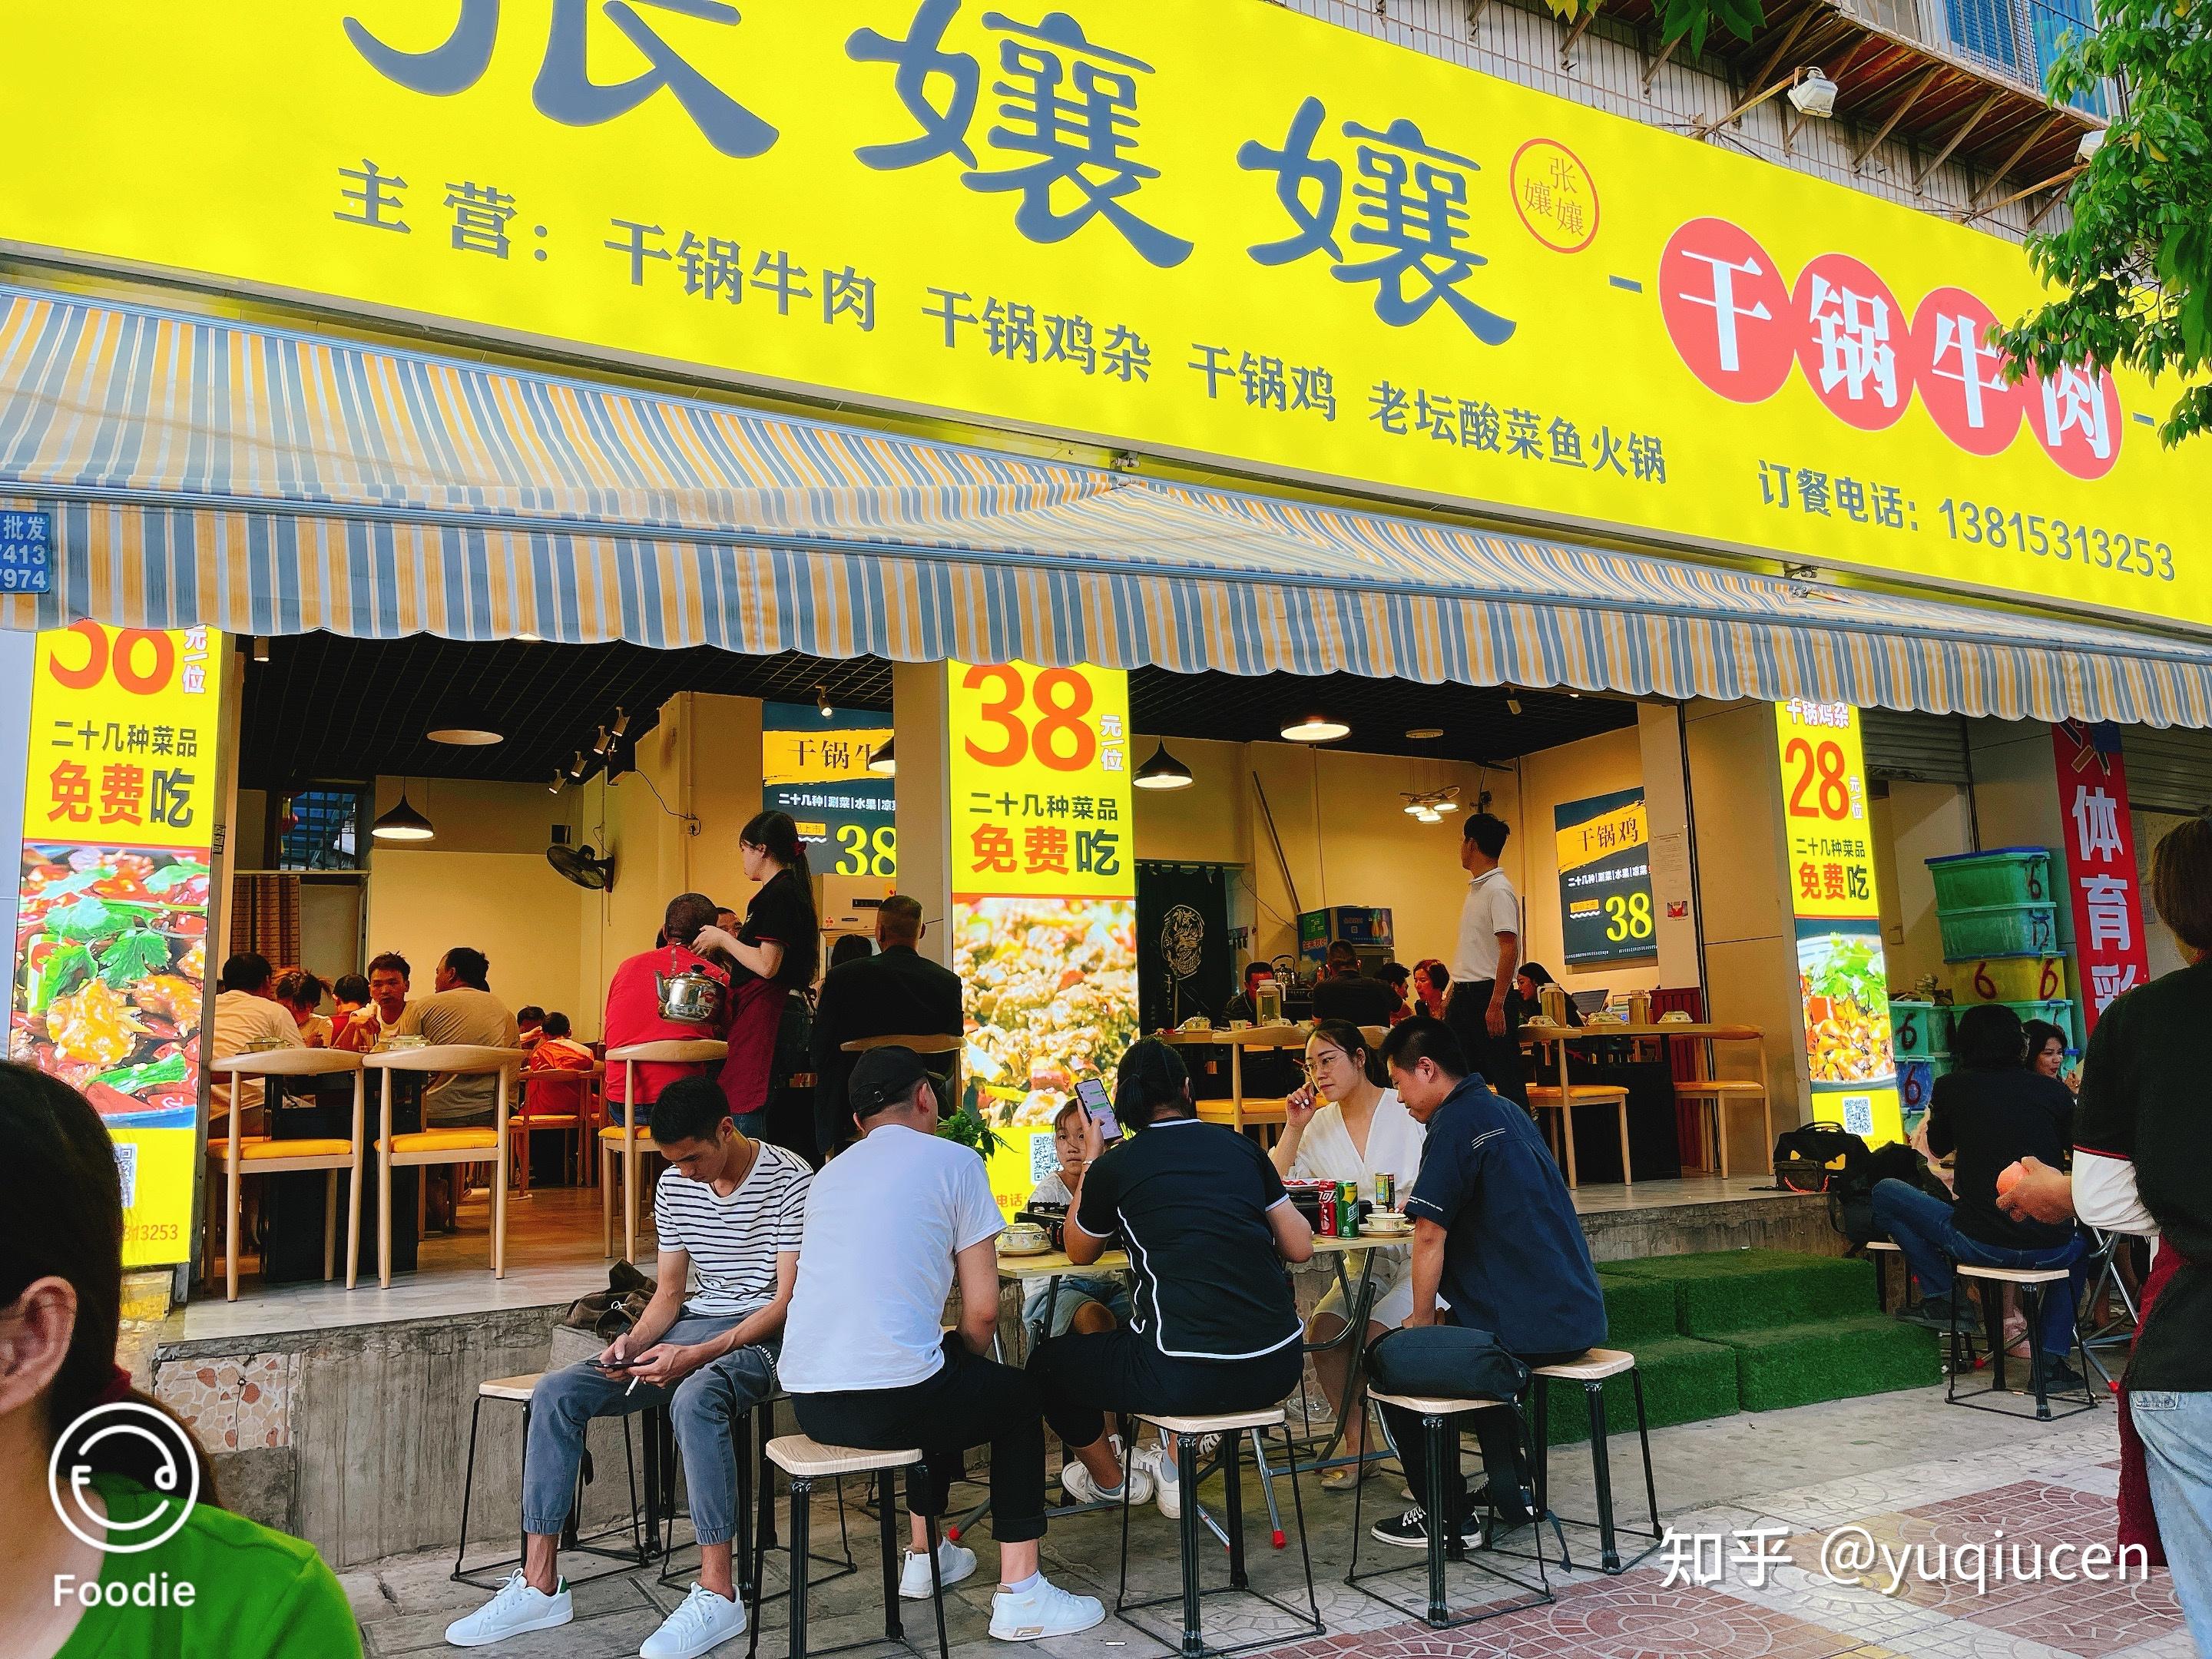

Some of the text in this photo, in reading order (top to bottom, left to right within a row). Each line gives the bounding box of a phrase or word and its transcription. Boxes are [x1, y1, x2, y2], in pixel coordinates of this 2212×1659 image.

[1548, 156, 1578, 195] 张
[604, 217, 876, 332] 干锅牛肉
[922, 286, 1152, 384] 干锅鸡杂
[1187, 343, 1336, 422] 干锅鸡
[1368, 381, 1667, 485] 老坛酸菜鱼火锅
[1679, 250, 2111, 459] 干锅牛肉
[3, 515, 46, 541] 批发
[1939, 498, 2174, 581] 13815313253
[0, 544, 46, 565] 413
[0, 568, 46, 589] 974
[51, 720, 198, 757] 二十几种菜品
[962, 664, 1096, 772] 38
[1099, 714, 1124, 771] 元一位
[48, 760, 196, 828] 免费吃
[1785, 737, 1849, 821] 28
[969, 792, 1119, 821] 二十几种菜品
[835, 824, 897, 877] 38
[971, 823, 1120, 877] 免费吃
[1577, 816, 1639, 853] 干锅鸡
[1796, 838, 1866, 859] 二十几种菜品
[1800, 862, 1870, 900] 免费吃
[1605, 892, 1653, 942] 38
[1975, 961, 1997, 1000] 6
[2040, 957, 2059, 1000] 6
[1896, 1012, 1919, 1051] 6
[1904, 1065, 1922, 1106] 6
